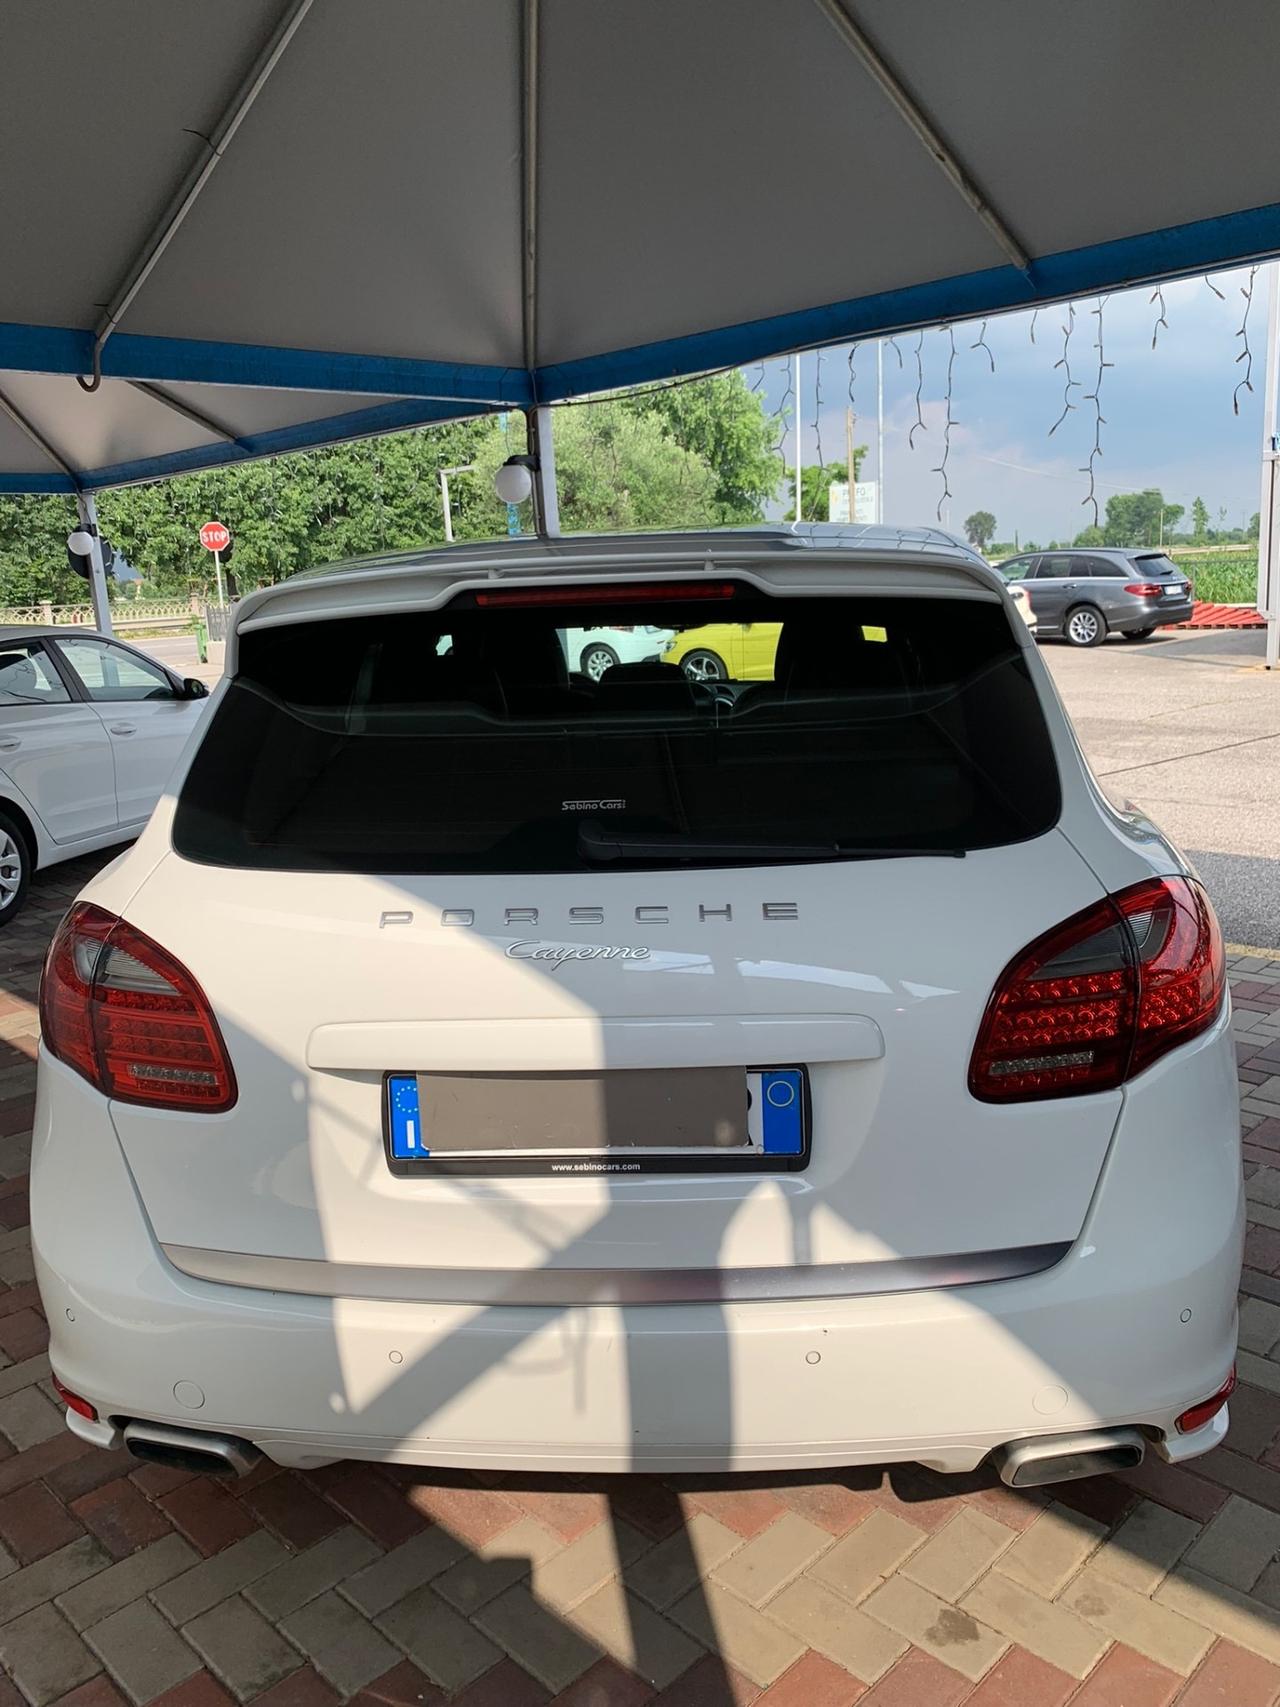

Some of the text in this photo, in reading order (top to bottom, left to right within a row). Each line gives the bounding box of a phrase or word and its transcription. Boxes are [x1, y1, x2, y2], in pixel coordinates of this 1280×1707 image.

[202, 531, 226, 542] STOP
[379, 902, 799, 929] PORSCHE
[505, 939, 651, 971] Cayenne
[551, 1163, 640, 1171] www.sabinocars.com
